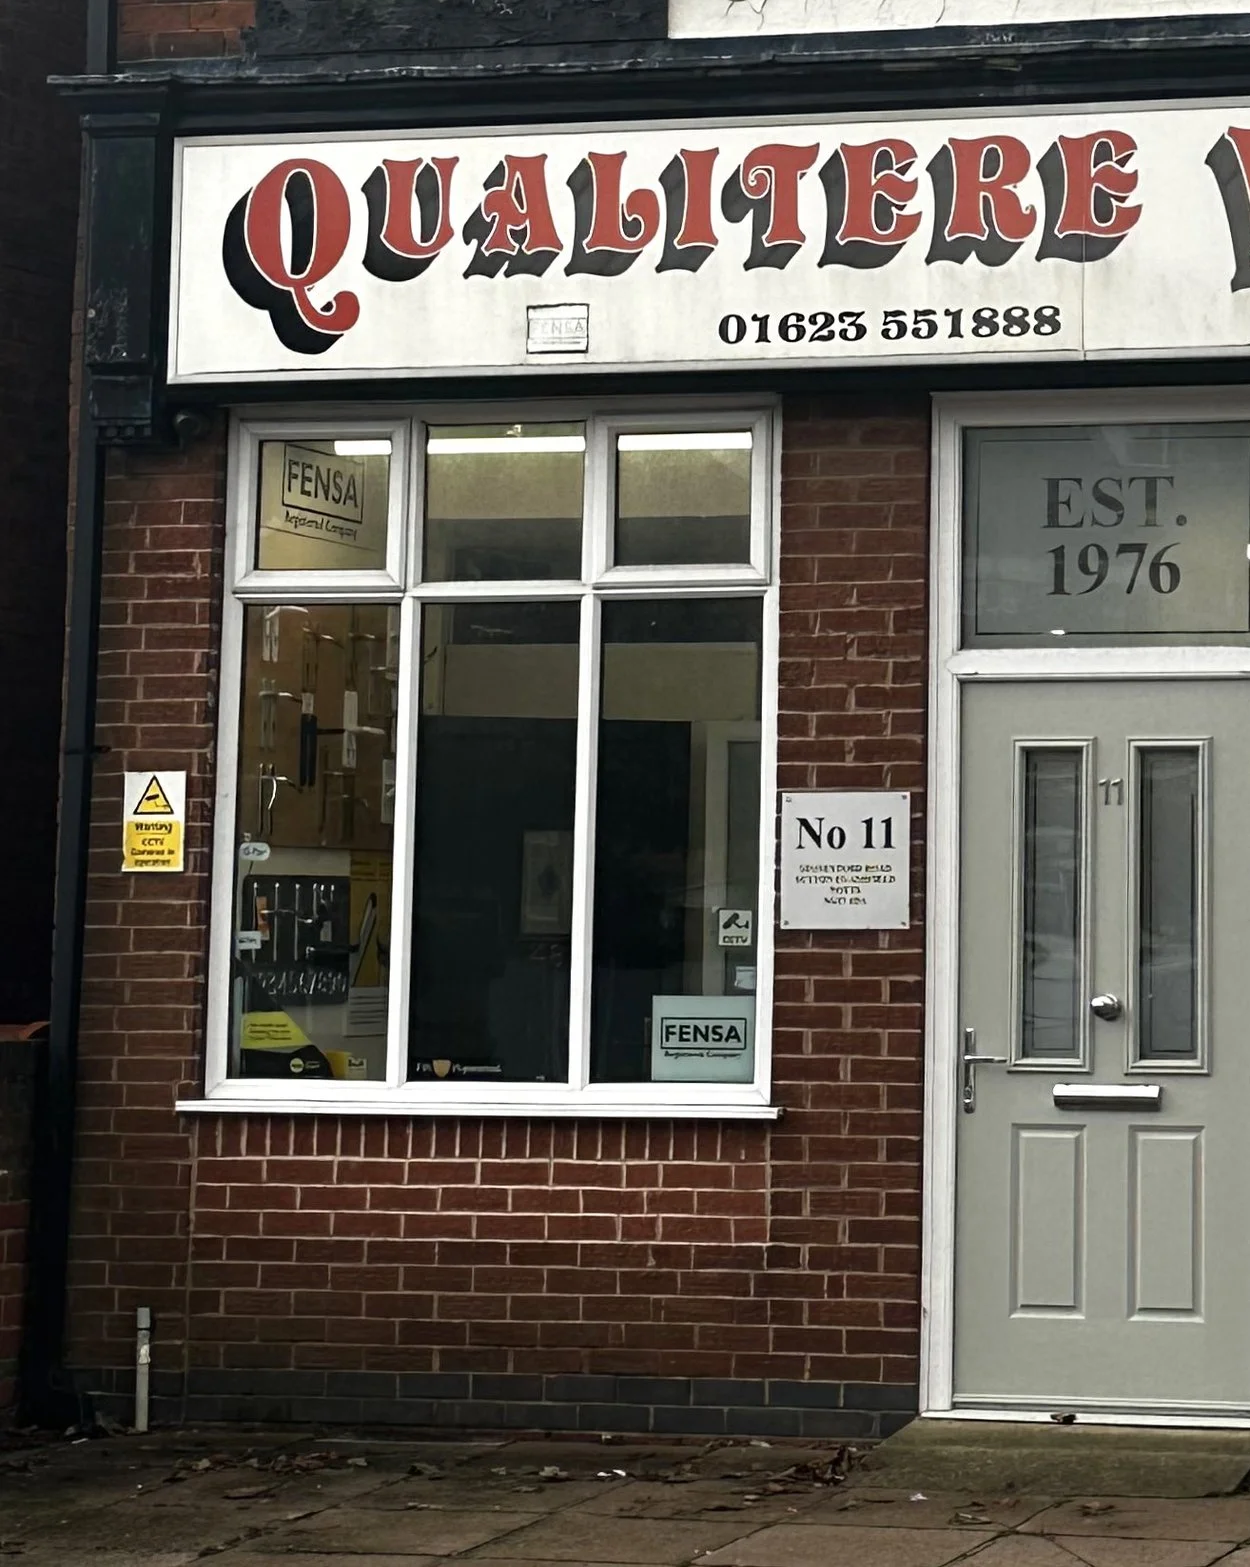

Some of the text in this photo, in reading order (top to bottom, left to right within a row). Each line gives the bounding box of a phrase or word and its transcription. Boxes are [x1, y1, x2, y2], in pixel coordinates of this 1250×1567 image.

[222, 130, 1143, 355] QUALITERE
[718, 305, 1062, 344] 01623 551888
[287, 458, 358, 509] FENSA
[1040, 475, 1188, 529] EST.
[1045, 542, 1182, 596] 1976
[1098, 778, 1123, 806] 11
[795, 817, 896, 850] No 11
[664, 1025, 742, 1043] FENSA
